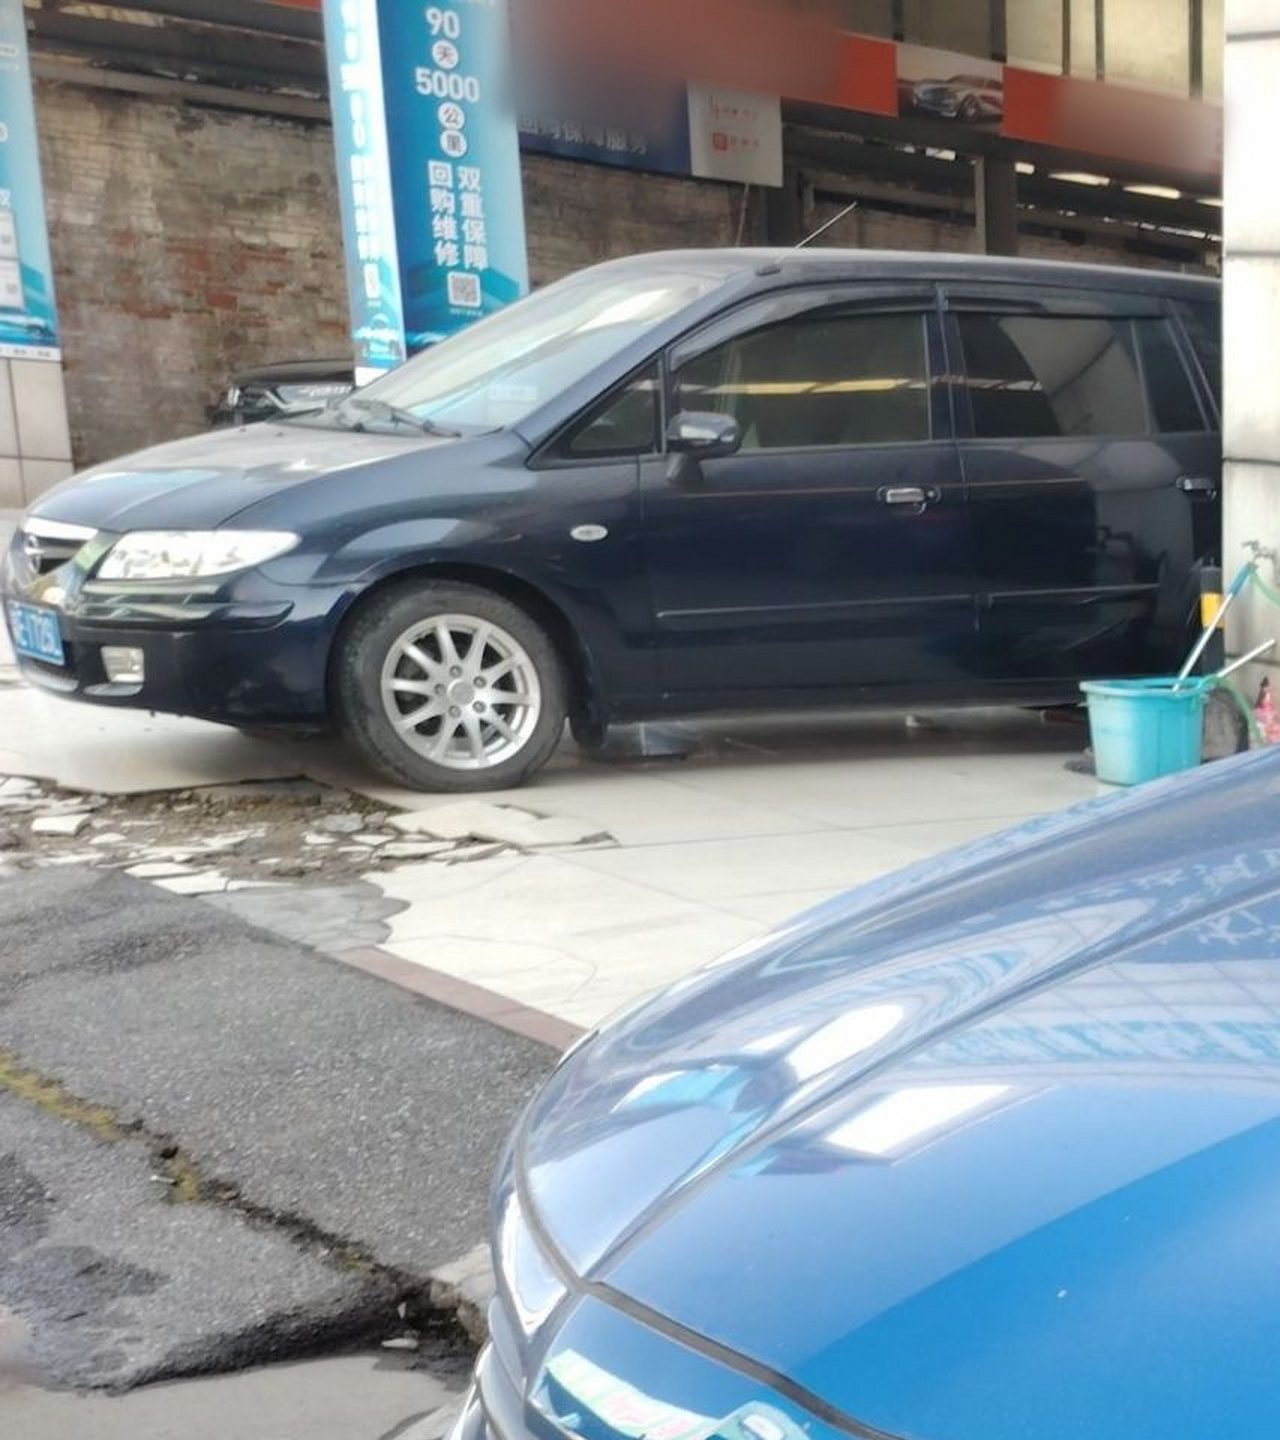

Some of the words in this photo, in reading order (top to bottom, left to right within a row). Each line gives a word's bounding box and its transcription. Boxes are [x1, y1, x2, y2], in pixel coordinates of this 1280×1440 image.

[425, 7, 460, 38] 90
[414, 66, 481, 103] 5000
[439, 104, 463, 156] 公里
[428, 160, 460, 266] 回购维修
[457, 165, 489, 270] 双重保障
